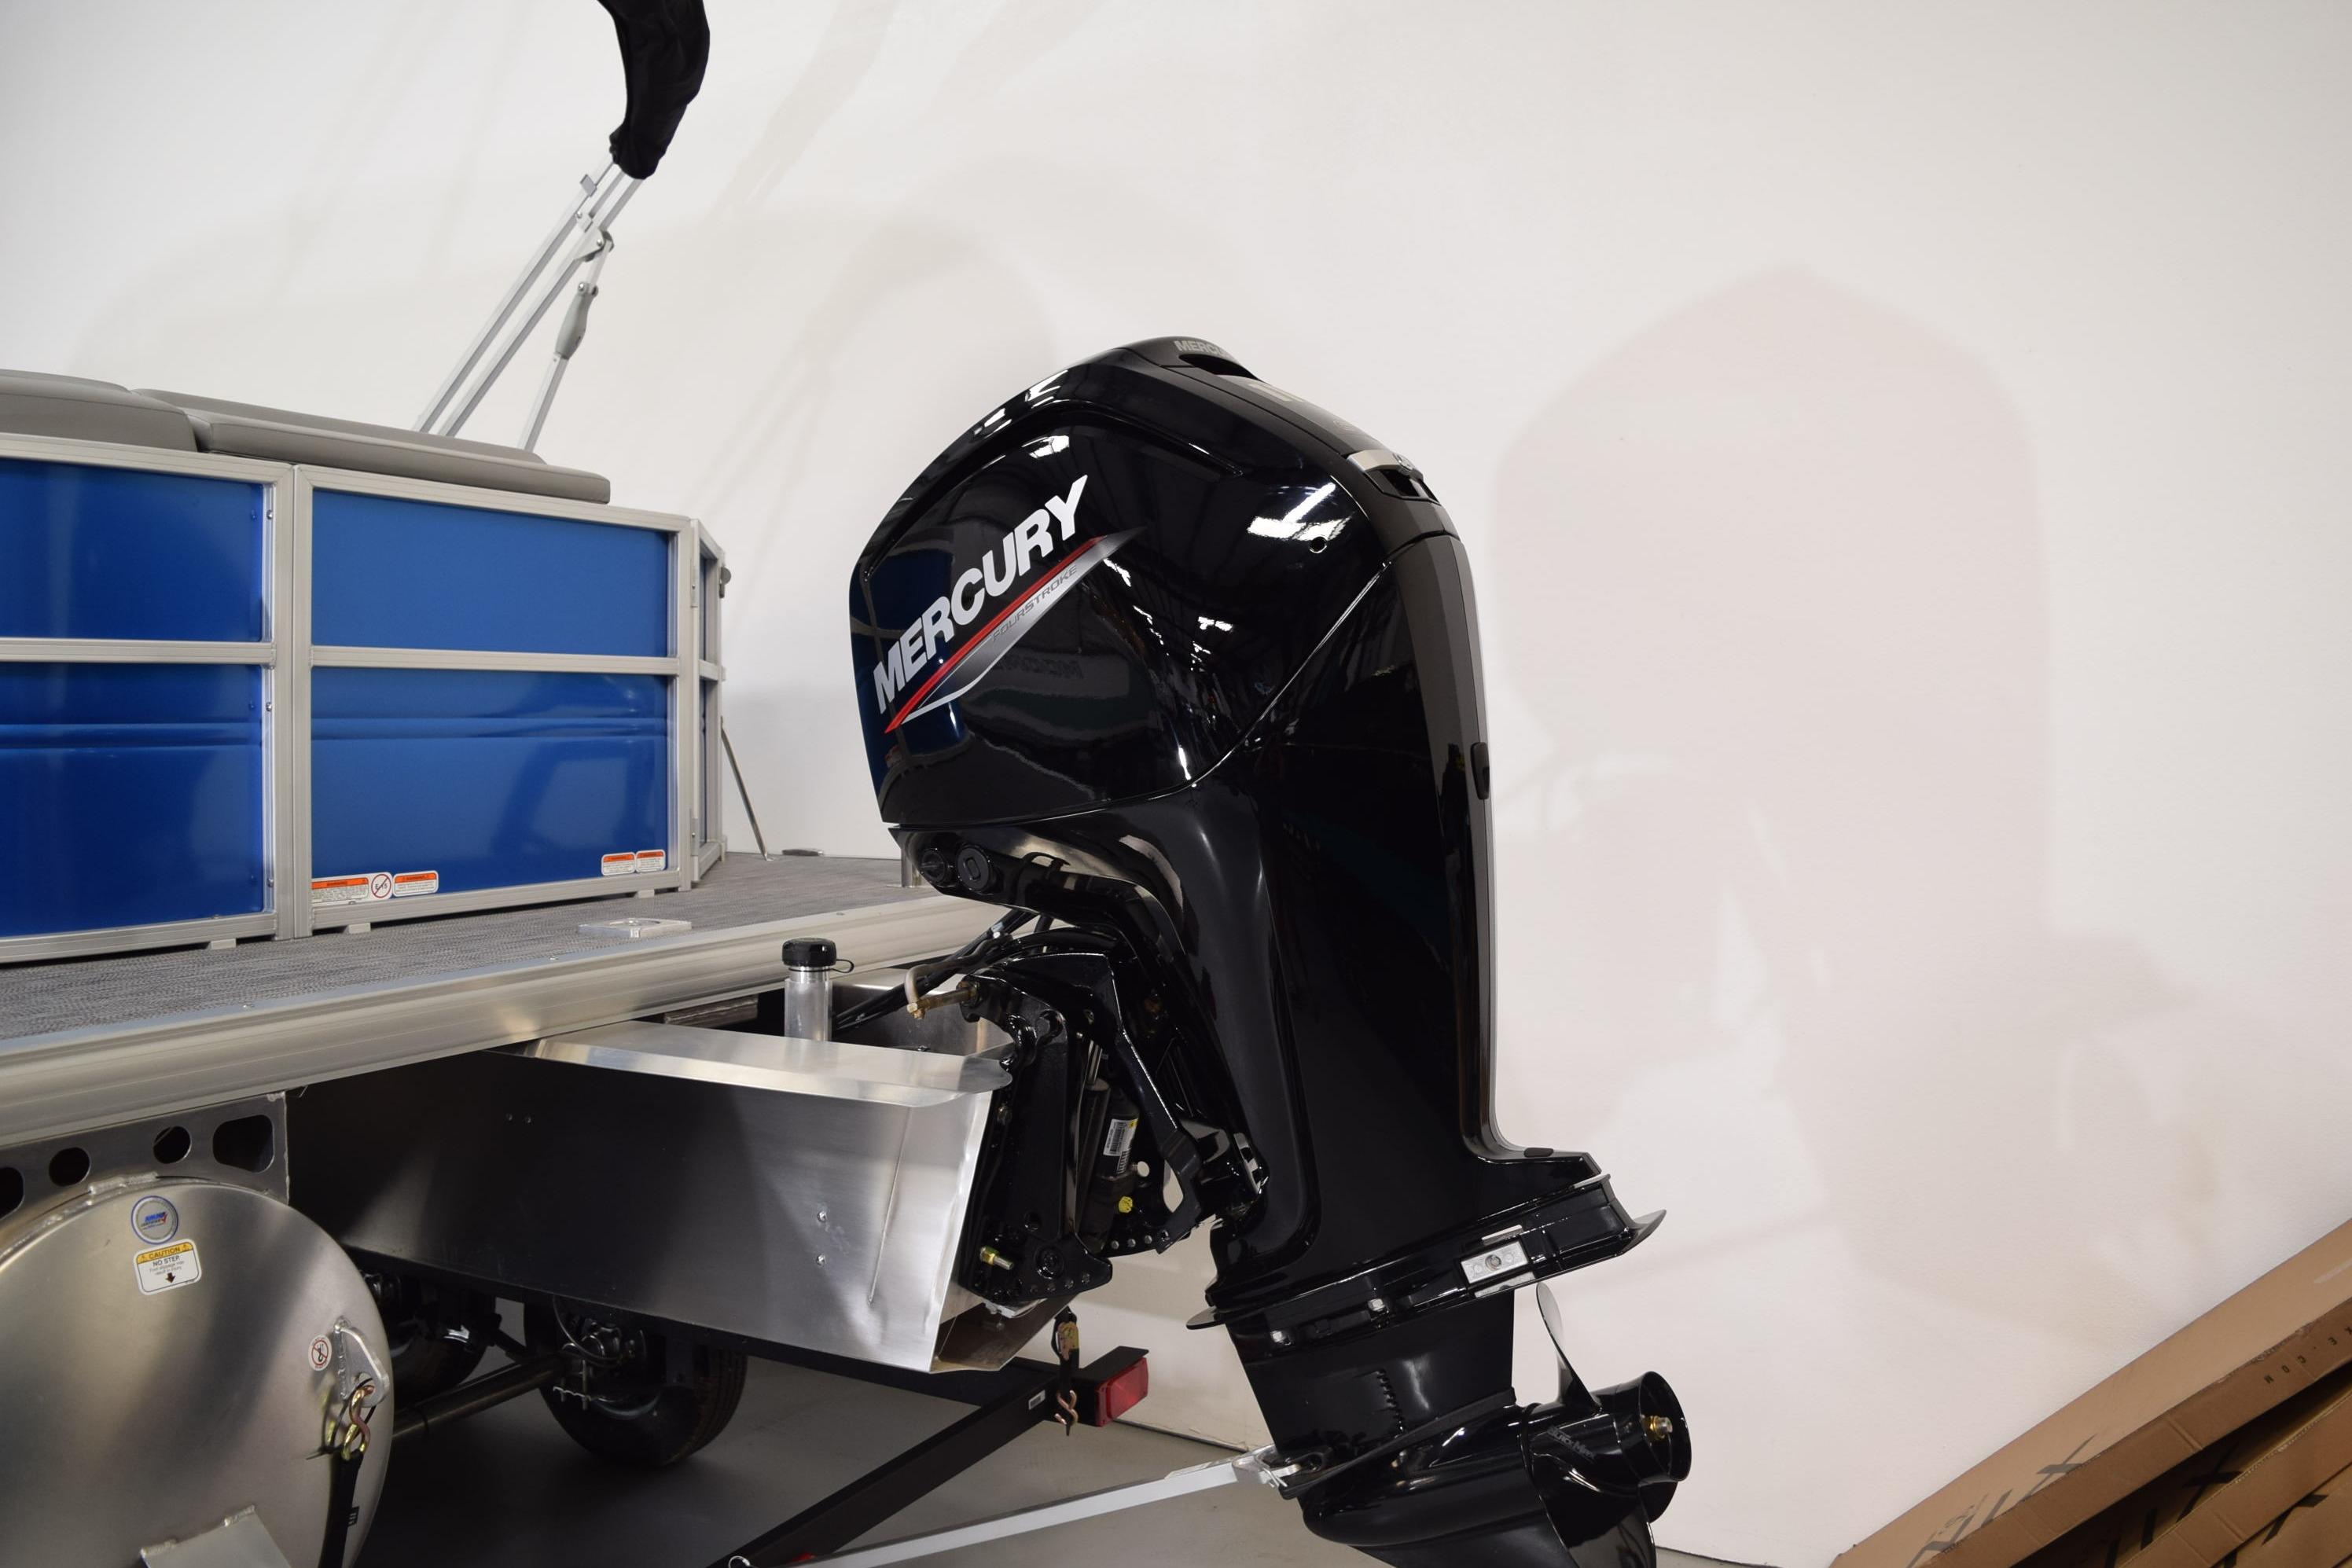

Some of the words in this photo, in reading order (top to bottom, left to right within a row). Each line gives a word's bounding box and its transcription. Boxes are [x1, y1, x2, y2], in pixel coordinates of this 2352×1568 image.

[873, 475, 1087, 714] MERCURY
[993, 564, 1077, 641] FOURSTROKE
[149, 1247, 180, 1259] CAUTION
